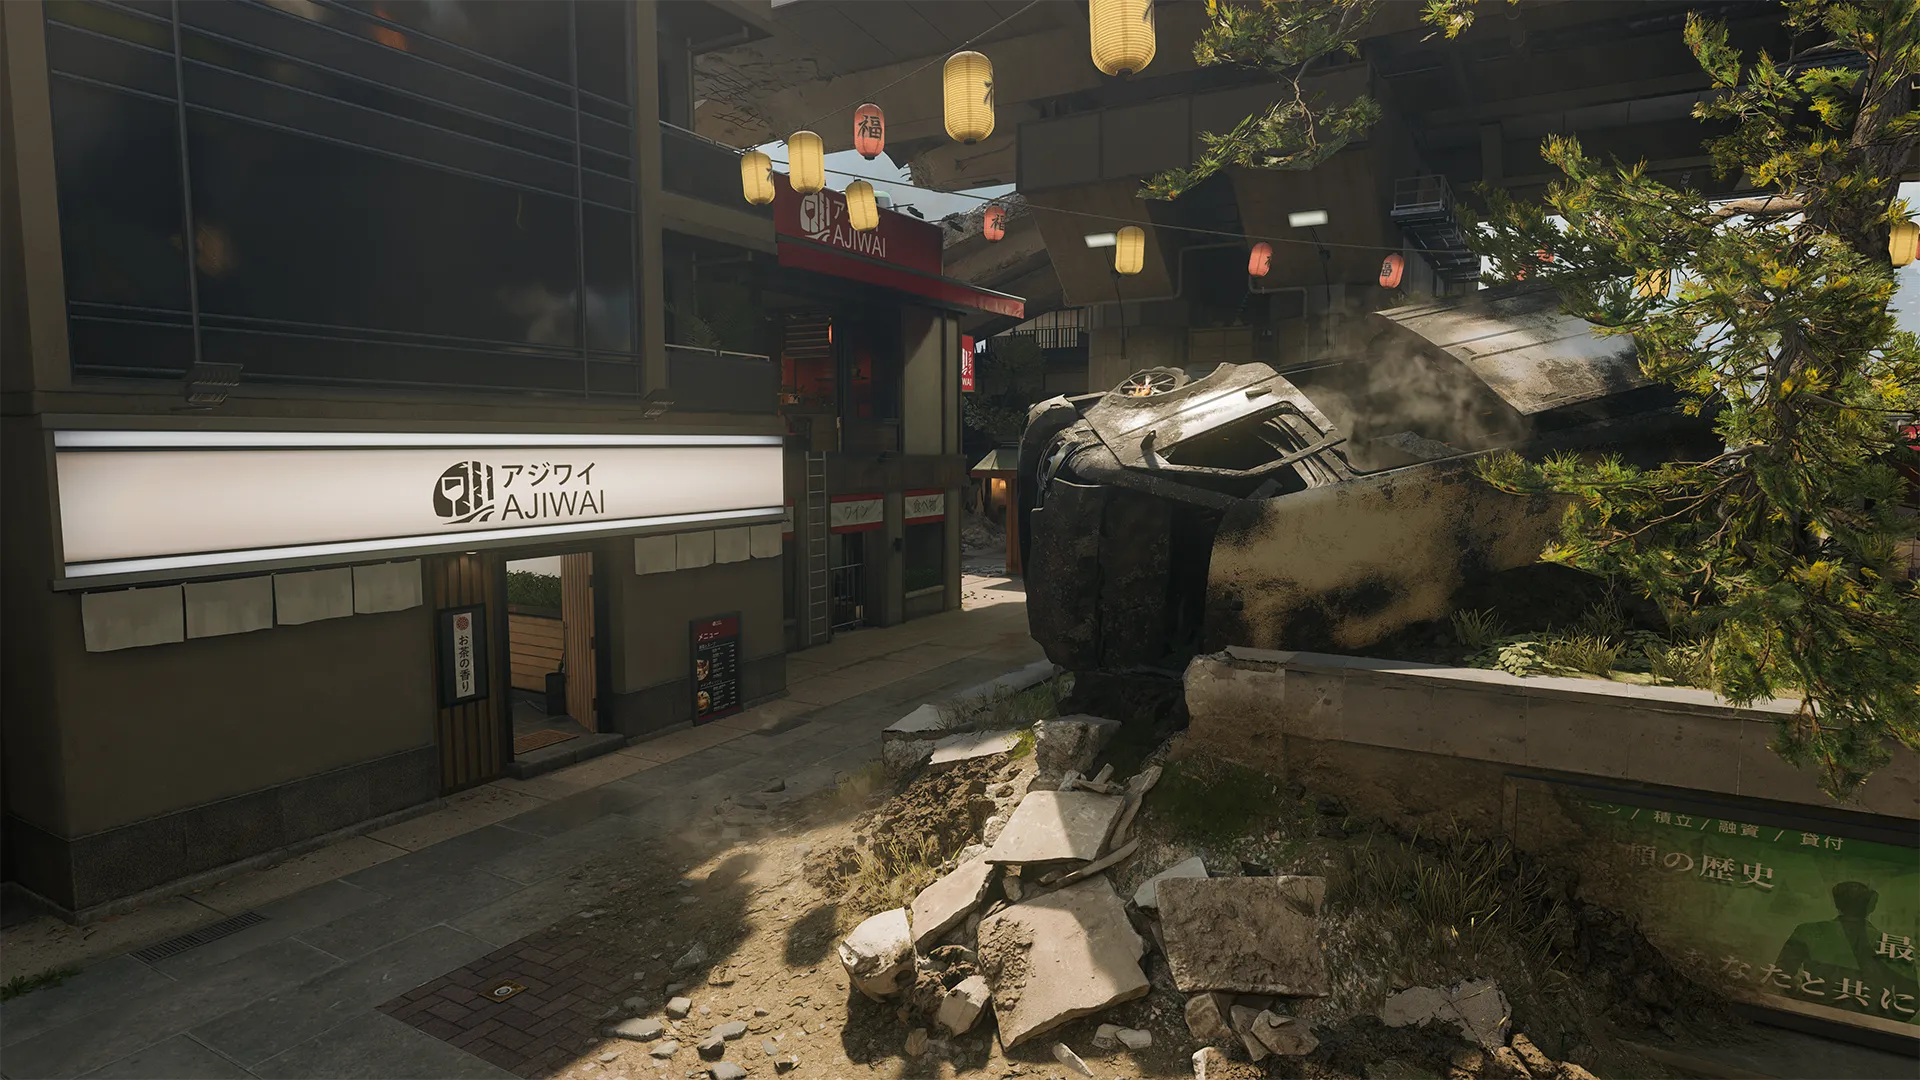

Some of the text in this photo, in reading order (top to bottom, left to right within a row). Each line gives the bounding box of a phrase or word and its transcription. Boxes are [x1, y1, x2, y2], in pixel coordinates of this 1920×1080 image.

[858, 114, 883, 139] 福
[832, 224, 886, 258] AJIWAI
[501, 462, 595, 488] アジワイ
[501, 490, 605, 521] AJIWAI
[844, 505, 869, 520] ワイン
[913, 497, 937, 514] 食べ物
[698, 632, 719, 642] メニュー
[458, 635, 471, 693] お茶の香り
[1653, 810, 1693, 828] 積立
[1718, 820, 1760, 839] 融資
[1800, 832, 1844, 851] 貸付
[1875, 932, 1916, 962] 最
